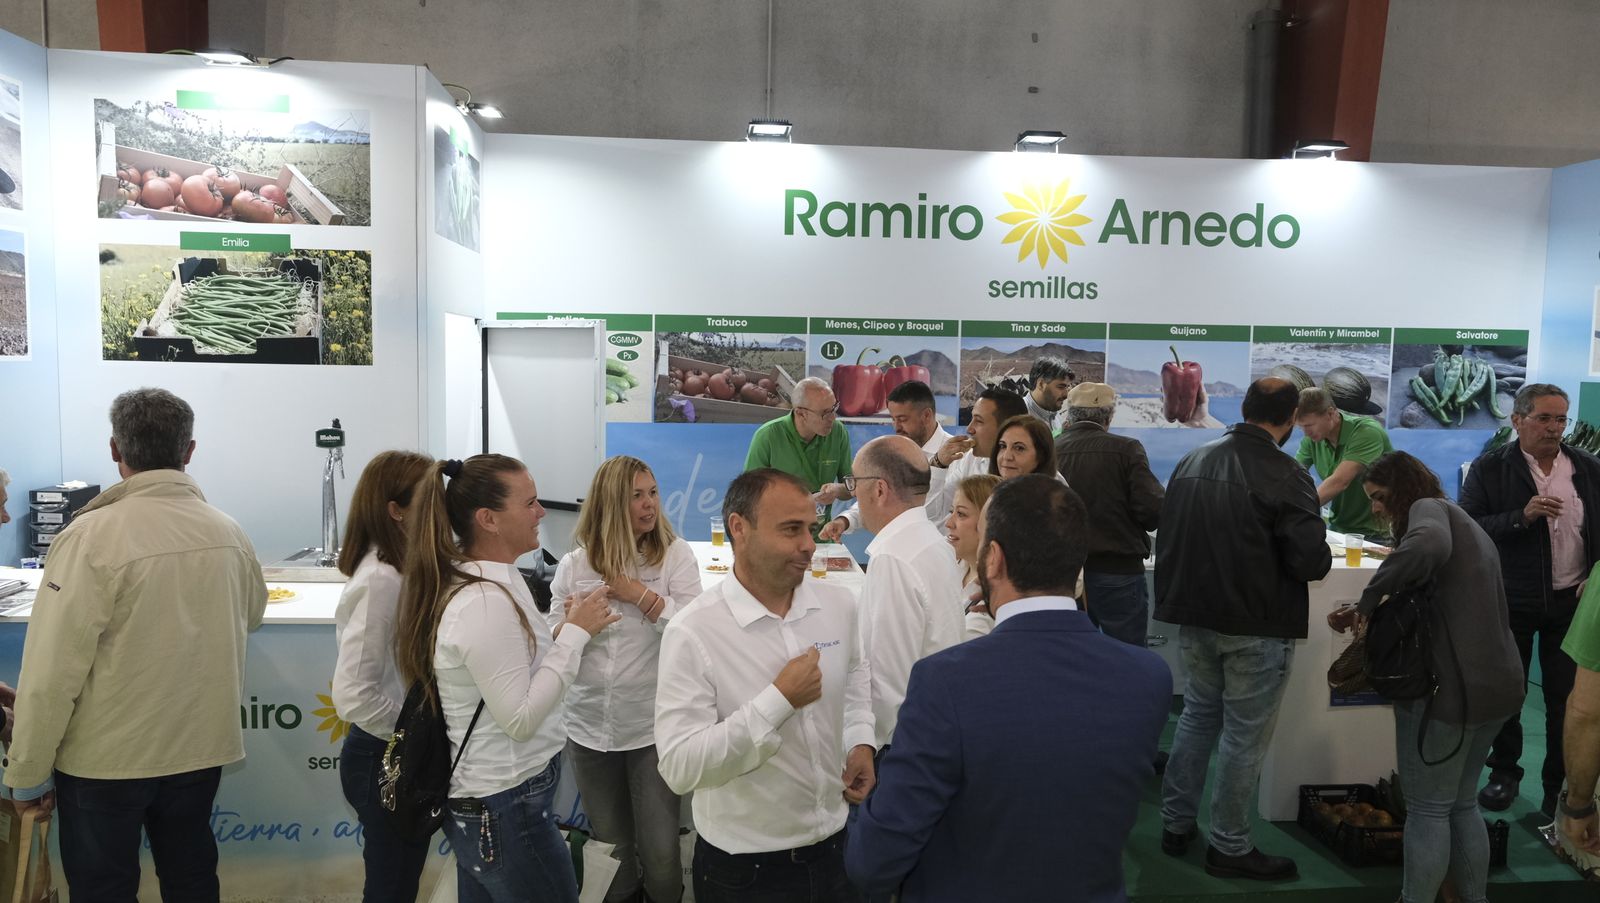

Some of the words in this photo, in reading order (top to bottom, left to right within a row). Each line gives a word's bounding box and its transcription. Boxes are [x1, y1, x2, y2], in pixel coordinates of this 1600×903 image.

[784, 189, 984, 241] Ramiro
[1097, 198, 1301, 249] Arnedo
[222, 237, 250, 247] Emilia
[988, 275, 1099, 300] semillas
[706, 317, 748, 327] Trabuco
[825, 320, 861, 330] Menes,
[862, 320, 896, 332] Clipeo
[898, 323, 904, 331] y
[906, 321, 944, 332] Broquel
[1011, 323, 1031, 332] Tina
[1033, 325, 1039, 333] y
[1041, 324, 1066, 333] Sade
[1170, 326, 1208, 337] Quijano
[1289, 328, 1327, 337] Valentín
[1329, 330, 1335, 338] y
[1337, 329, 1380, 338] Mirambel
[610, 335, 639, 344] CGMMV
[1456, 330, 1498, 340] Salvatore
[826, 343, 839, 357] Lt
[623, 351, 632, 360] Px
